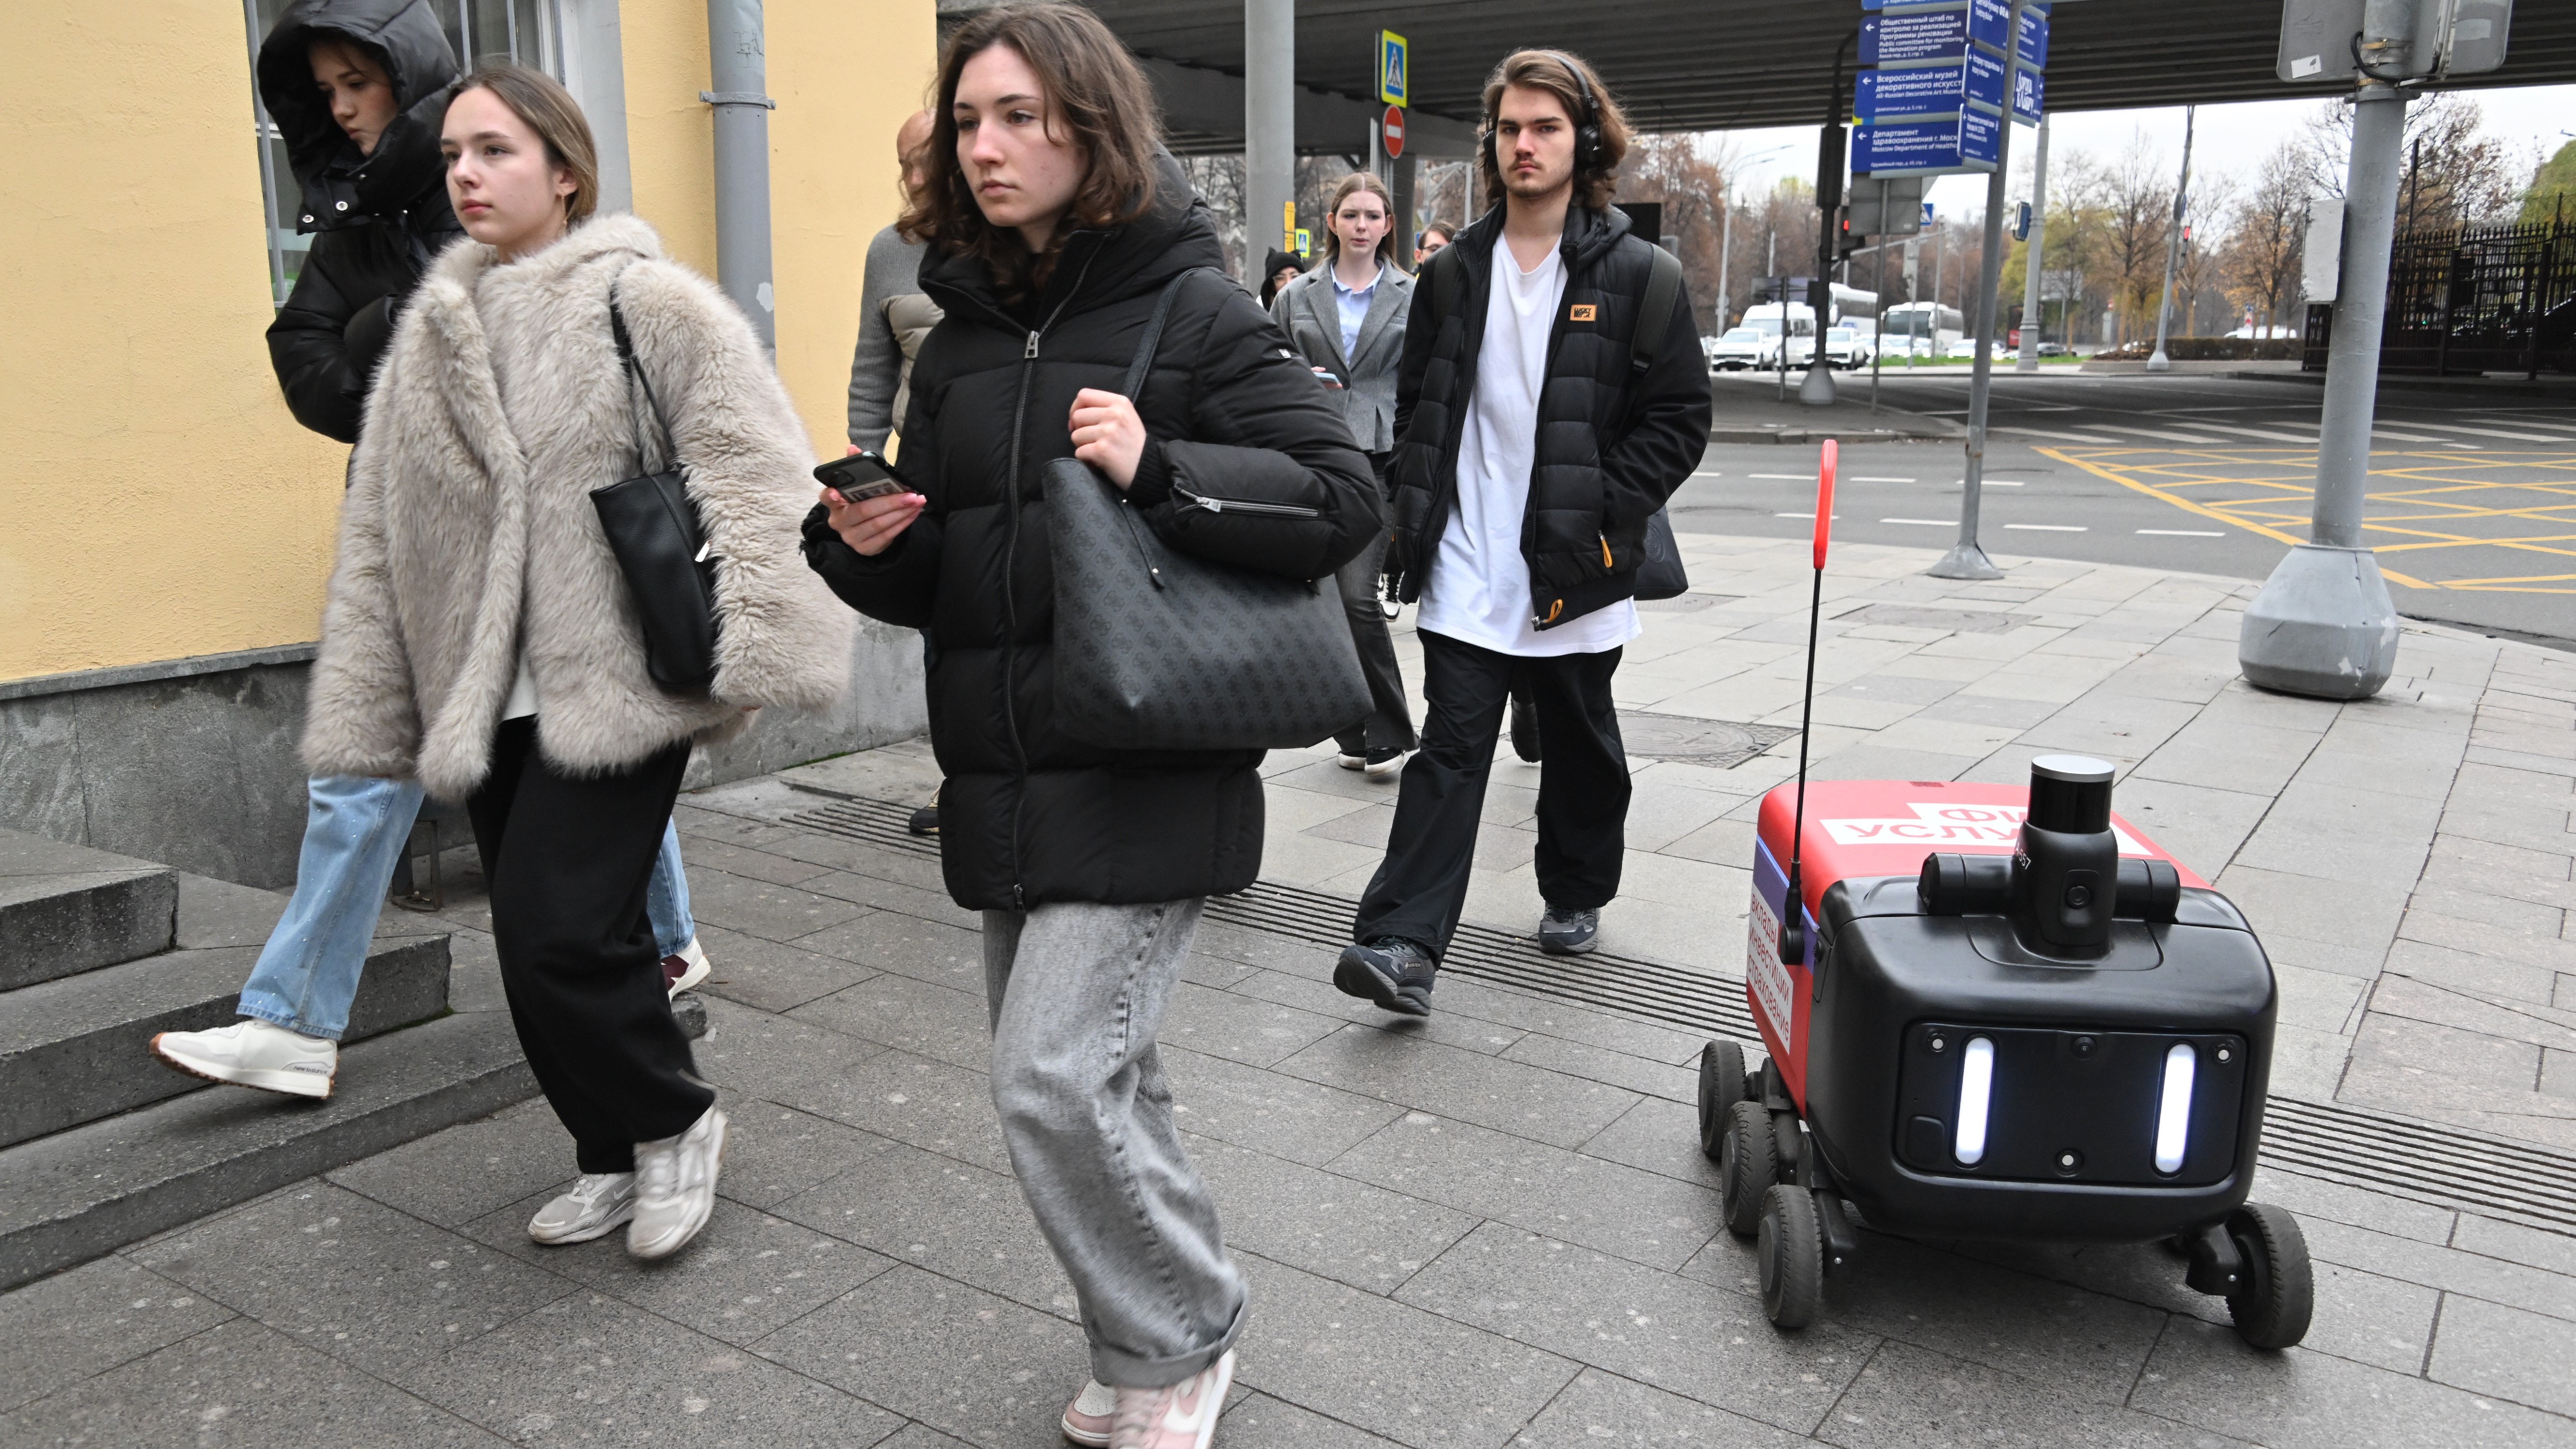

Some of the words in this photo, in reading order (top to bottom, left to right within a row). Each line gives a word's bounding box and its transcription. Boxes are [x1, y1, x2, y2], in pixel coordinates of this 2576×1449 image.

[1880, 16, 1928, 26] Общественный
[1920, 21, 1962, 31] реализацией
[1917, 30, 1953, 38] реновации
[1877, 73, 1933, 83] Всероссийский
[1935, 70, 1958, 79] музей
[1875, 81, 1932, 92] декоративного
[1933, 80, 1962, 89] искусст
[1873, 129, 1918, 138] Департамент
[1873, 136, 1933, 145] здравоохранения
[1939, 808, 2028, 823] ФИ
[1843, 824, 2020, 840] УСЛУ
[1751, 892, 1778, 947] вклады
[1749, 923, 1789, 1006] инвестиции
[1747, 954, 1790, 1041] страхование
